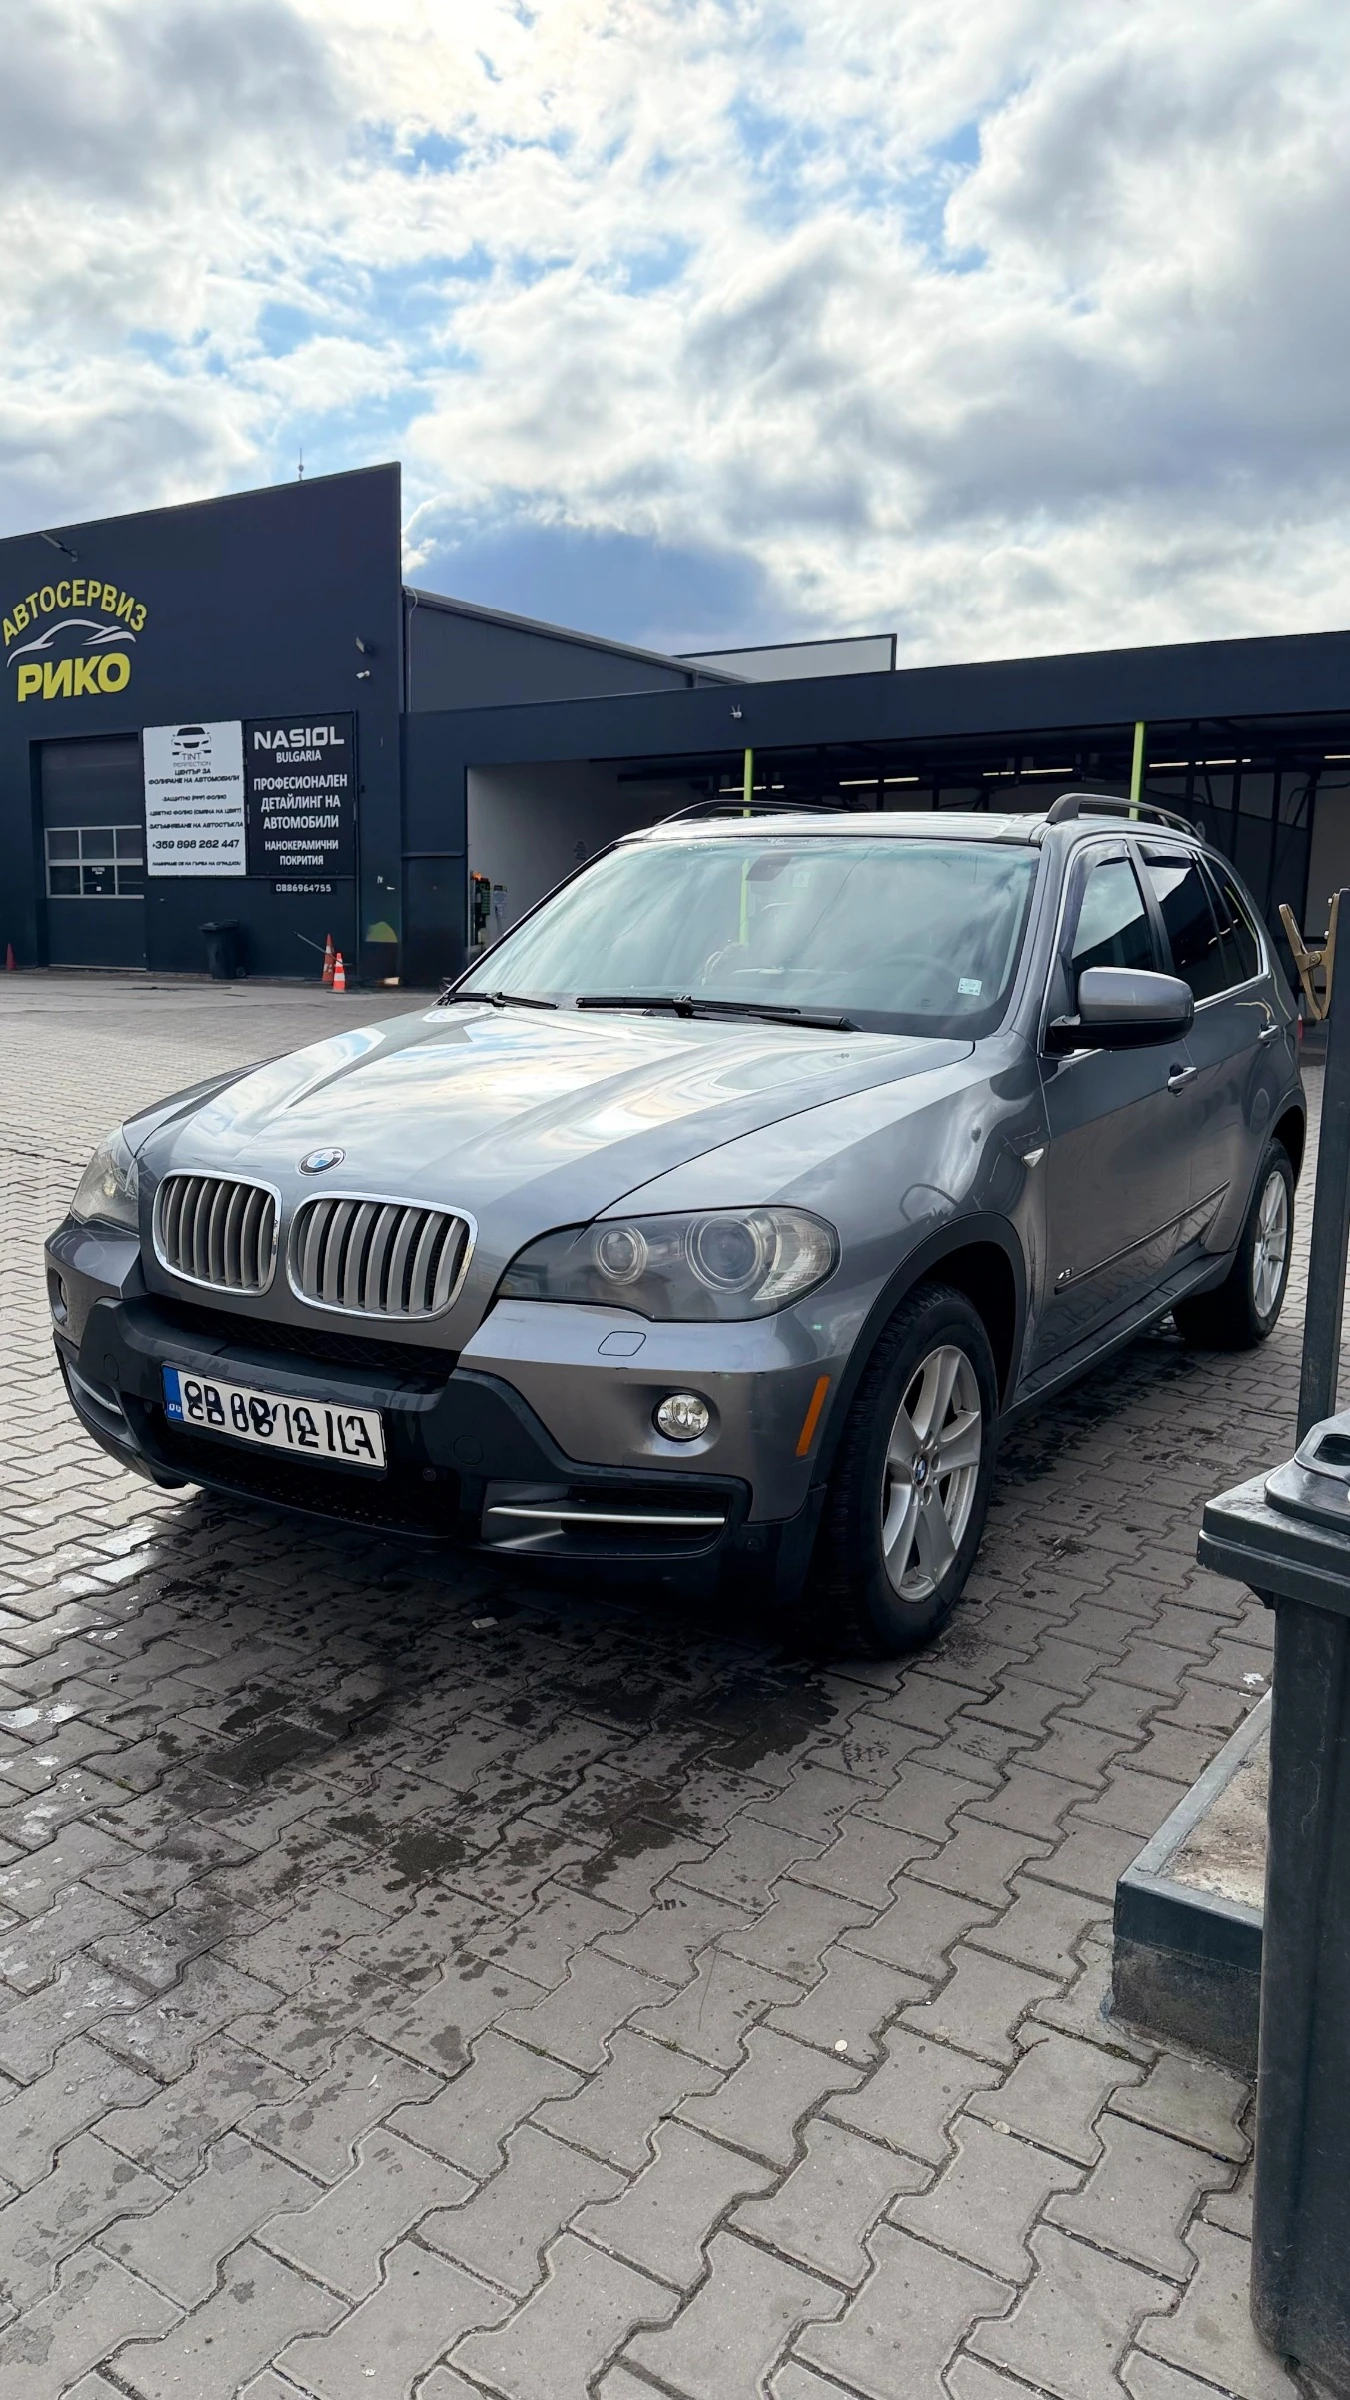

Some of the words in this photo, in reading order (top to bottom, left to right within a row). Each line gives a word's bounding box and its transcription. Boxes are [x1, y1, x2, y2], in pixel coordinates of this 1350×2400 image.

[2, 579, 148, 647] АВТОСЕРВИЗ
[17, 652, 131, 703] РИКО
[254, 726, 345, 750] NASIOL
[182, 752, 201, 761] TINT
[276, 750, 322, 764] BULGARIA
[194, 775, 240, 783] АВТОМОБИЛИ
[253, 774, 348, 791] ПРОФЕСИОНАЛЕН
[261, 793, 323, 813] ДЕТАЙЛИНГ
[325, 795, 341, 808] НА
[263, 815, 339, 829] АВТОМОБИЛИ
[152, 840, 175, 849] +359
[176, 839, 196, 849] 898
[198, 839, 219, 849] 262
[221, 839, 240, 848] 447
[264, 839, 339, 851] НАНОКЕРАМИЧНИ
[279, 855, 324, 866] ПОКРИТИЯ
[275, 884, 332, 893] 0886964755
